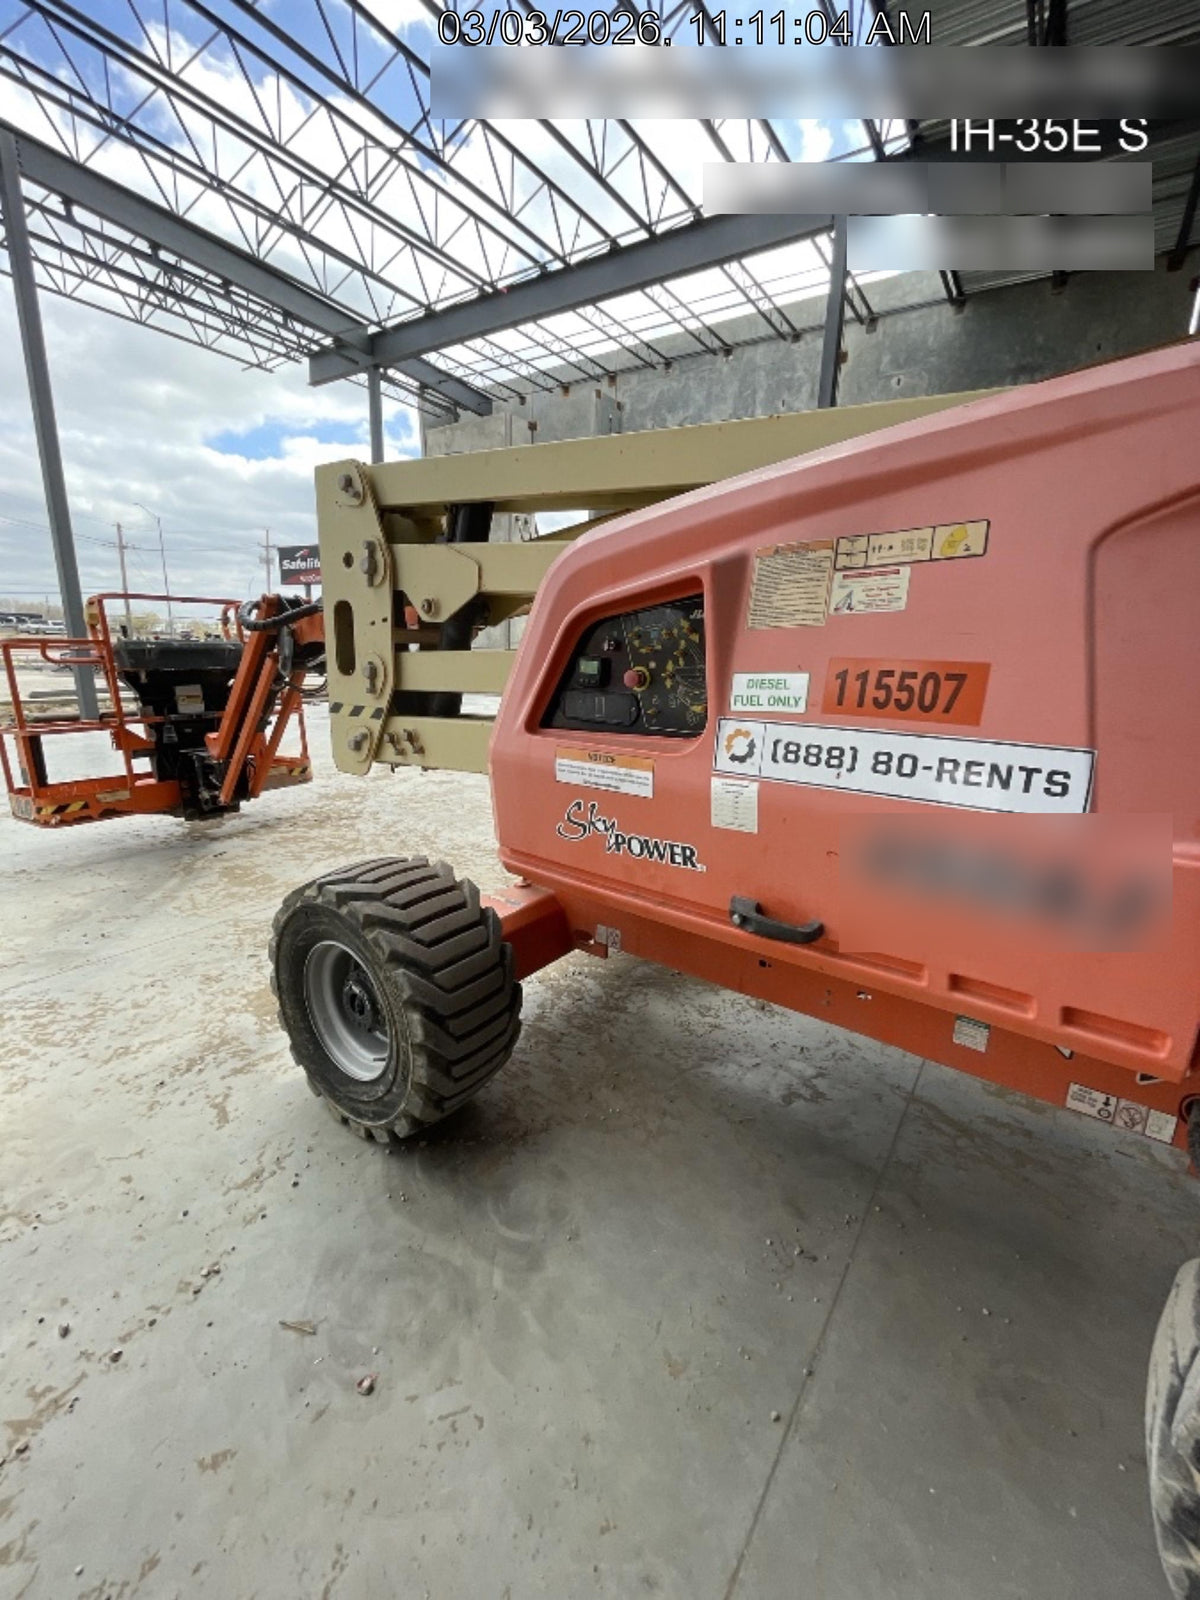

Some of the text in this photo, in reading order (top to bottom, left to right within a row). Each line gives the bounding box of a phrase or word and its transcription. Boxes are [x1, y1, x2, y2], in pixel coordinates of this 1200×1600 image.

[747, 678, 791, 690] DIESEL
[835, 668, 968, 714] 115507
[733, 694, 802, 708] FUEL ONLY
[770, 739, 1072, 799] (888) 80-RENTS
